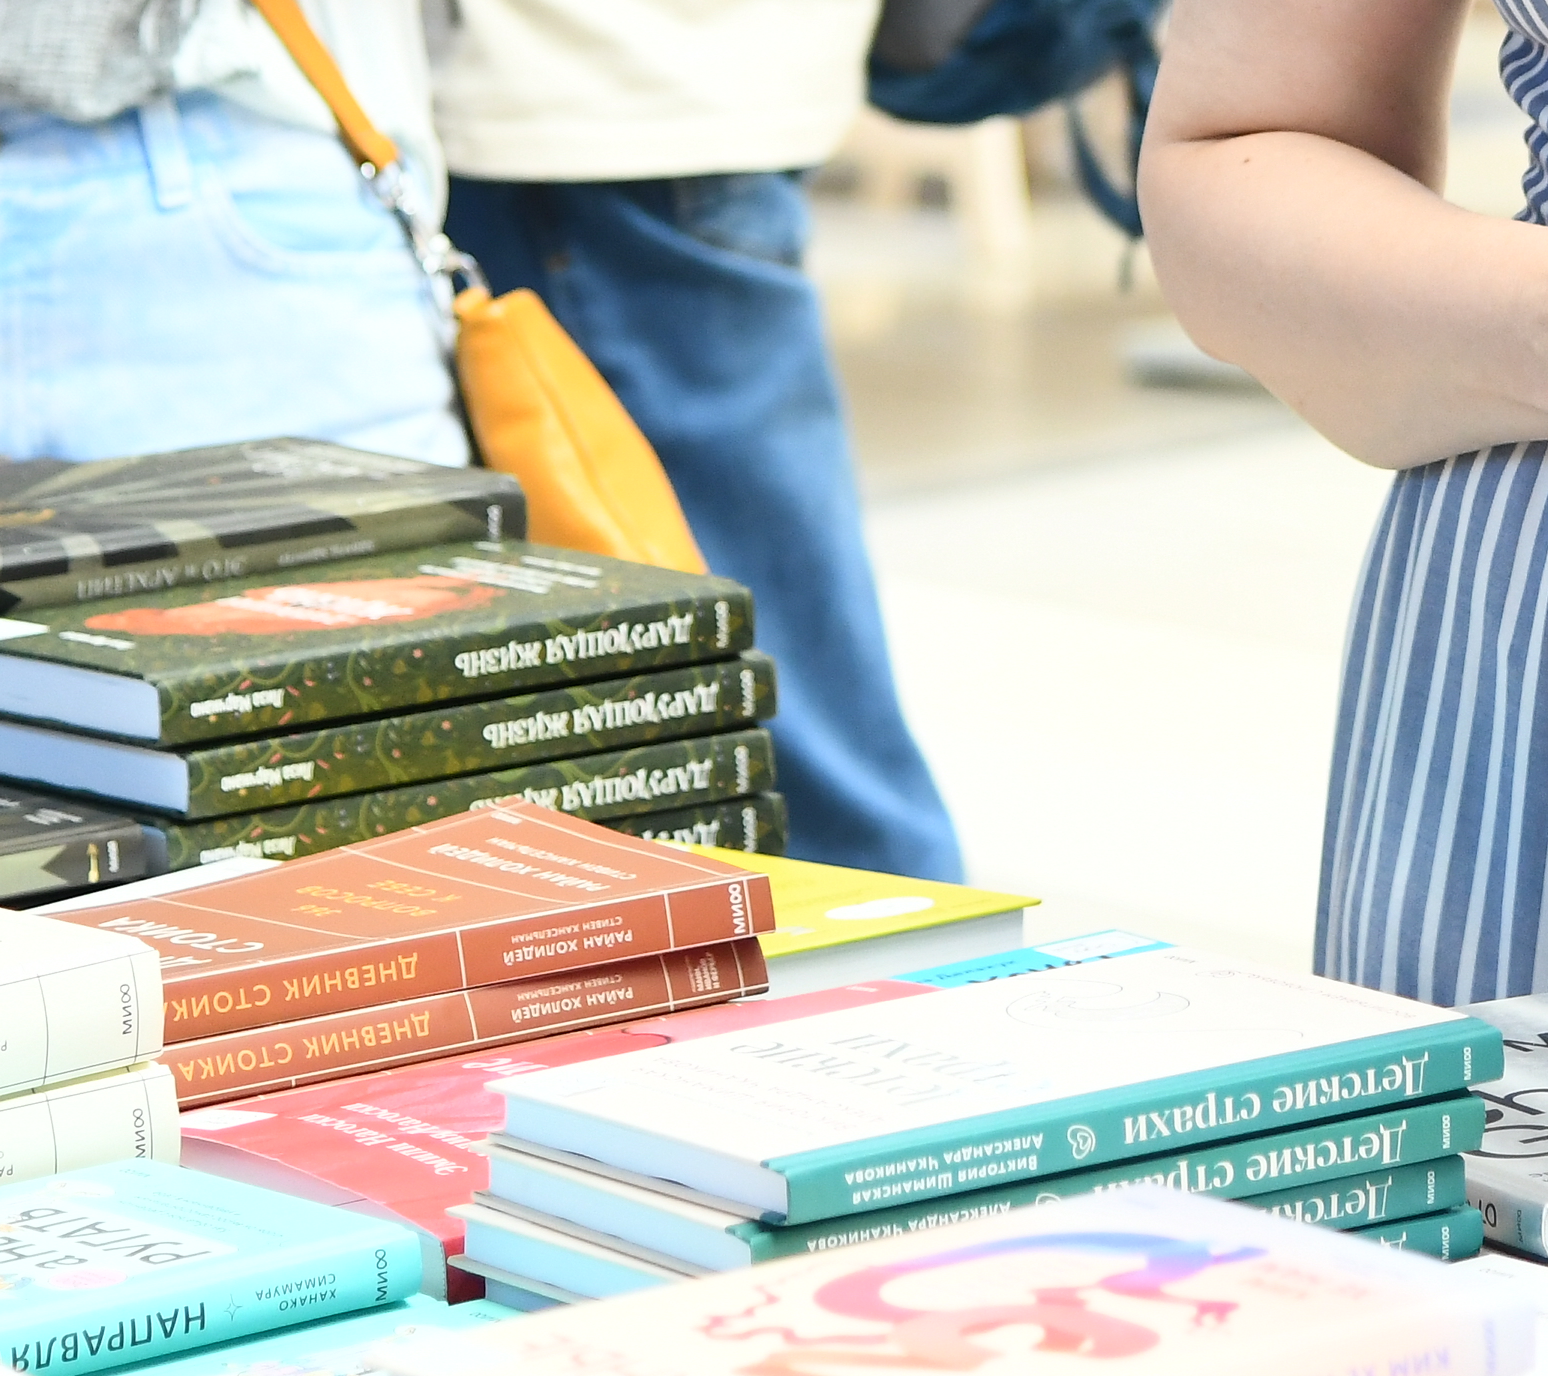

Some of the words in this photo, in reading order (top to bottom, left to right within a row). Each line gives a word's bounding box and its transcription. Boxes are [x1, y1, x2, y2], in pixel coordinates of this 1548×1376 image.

[544, 612, 694, 665] ДАРУЮЩАЯ
[453, 640, 543, 678] ЖИЗНЬ
[571, 681, 720, 735] ДАРУЮЩАЯ
[481, 710, 571, 749] ЖИЗНЬ
[559, 756, 713, 811] ДАРУЮЩАЯ
[509, 922, 581, 945] ХАНСЕЛЬМАН
[581, 915, 624, 933] СТИВЕН
[582, 928, 634, 950] РАЙАН
[502, 939, 580, 967] ХОЛИДЕЙ
[281, 952, 419, 1002] ДНЕВНИК
[515, 981, 583, 1003] ХАНСЕЛЬМАН
[582, 973, 624, 992] СТИВЕН
[585, 986, 634, 1005] РАЙАН
[163, 984, 272, 1023] СТОИК
[509, 997, 583, 1024] ХОЛИДЕЙ
[301, 1010, 431, 1060] ДНЕВНИК
[177, 1043, 293, 1083] СТОИКА
[1273, 1051, 1430, 1125] Детские
[297, 1113, 392, 1148] Нагоски
[1122, 1093, 1262, 1146] страхи
[1246, 1120, 1407, 1183] Детские
[3, 1207, 213, 1268] РУГАТЬ
[254, 1271, 338, 1302] СИМАМУРА
[278, 1287, 339, 1312] ХАНАКО
